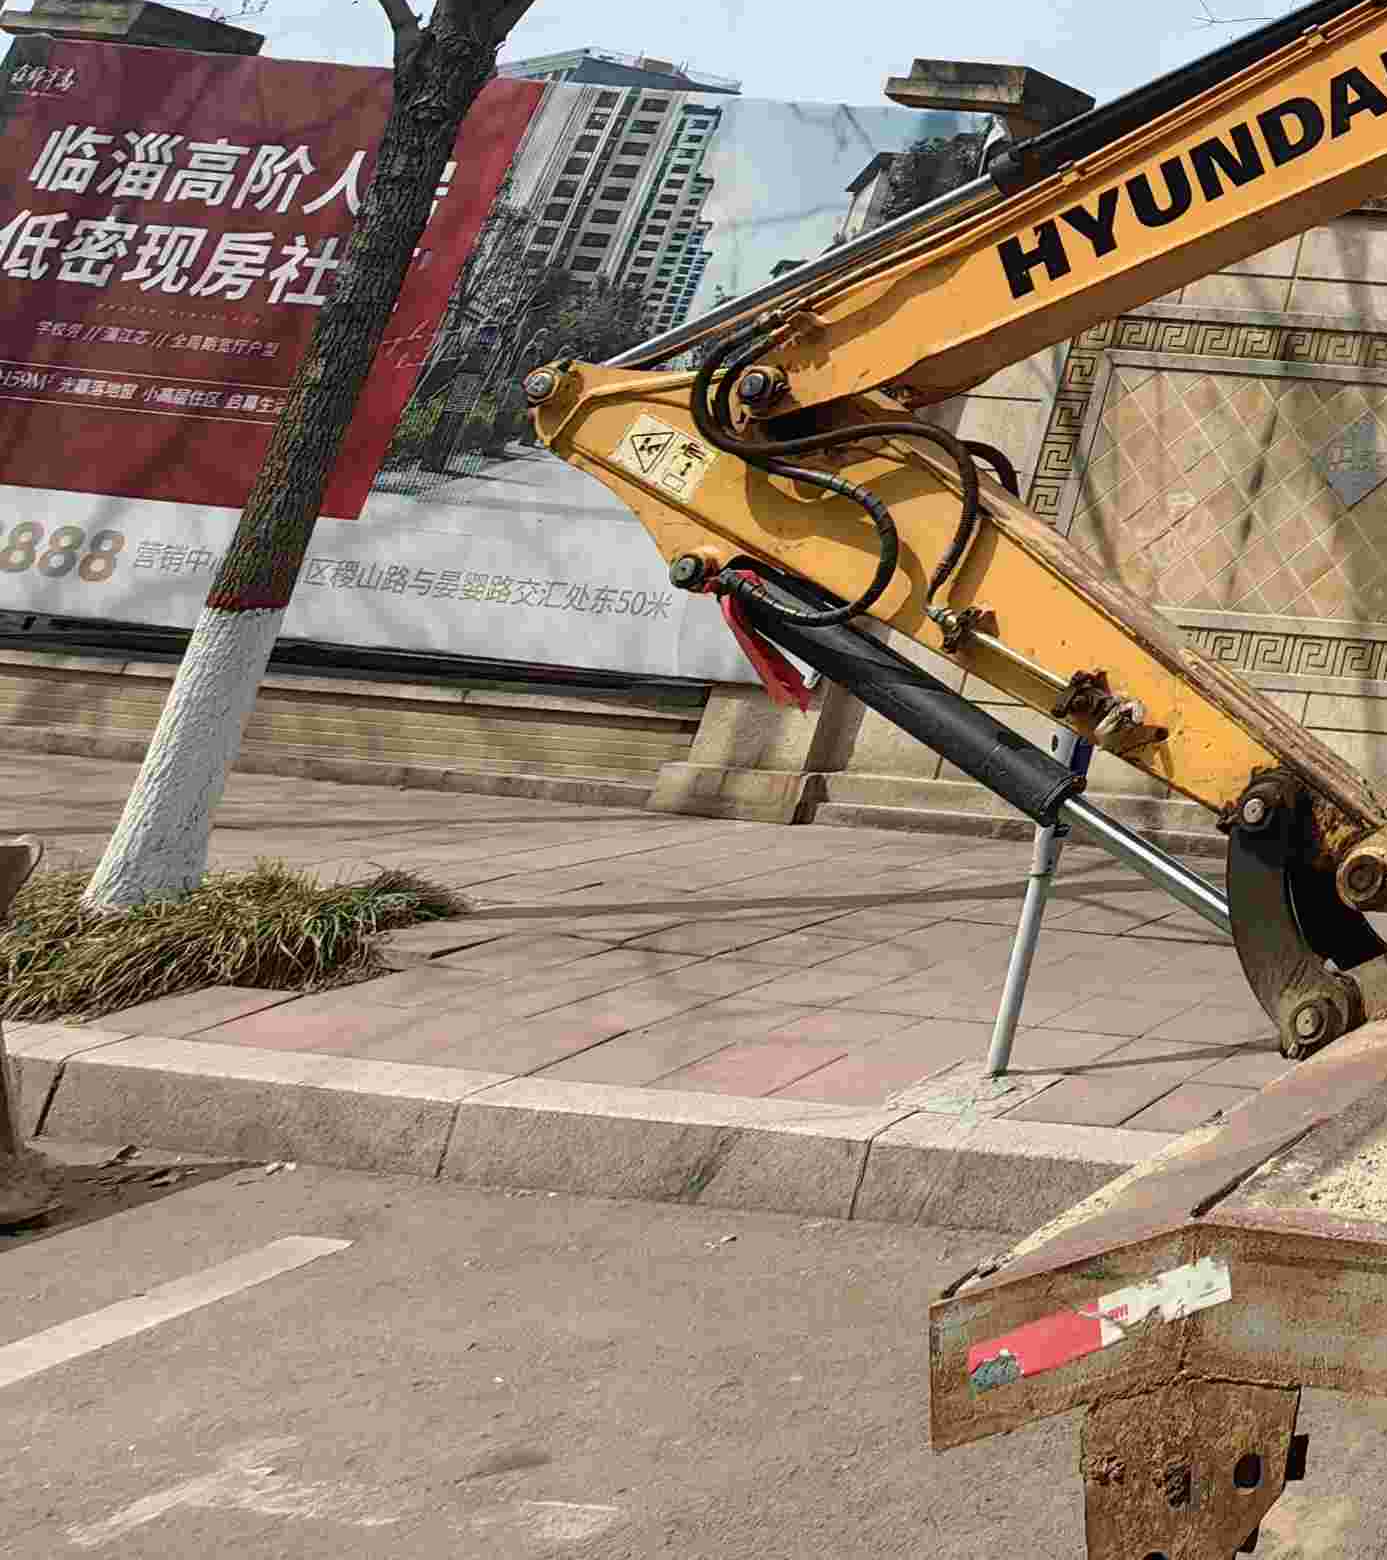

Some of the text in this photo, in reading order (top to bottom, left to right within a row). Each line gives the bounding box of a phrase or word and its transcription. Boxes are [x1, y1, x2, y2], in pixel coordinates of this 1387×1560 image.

[29, 123, 458, 228] 临淄高阶人
[0, 208, 430, 308] 低密现房社
